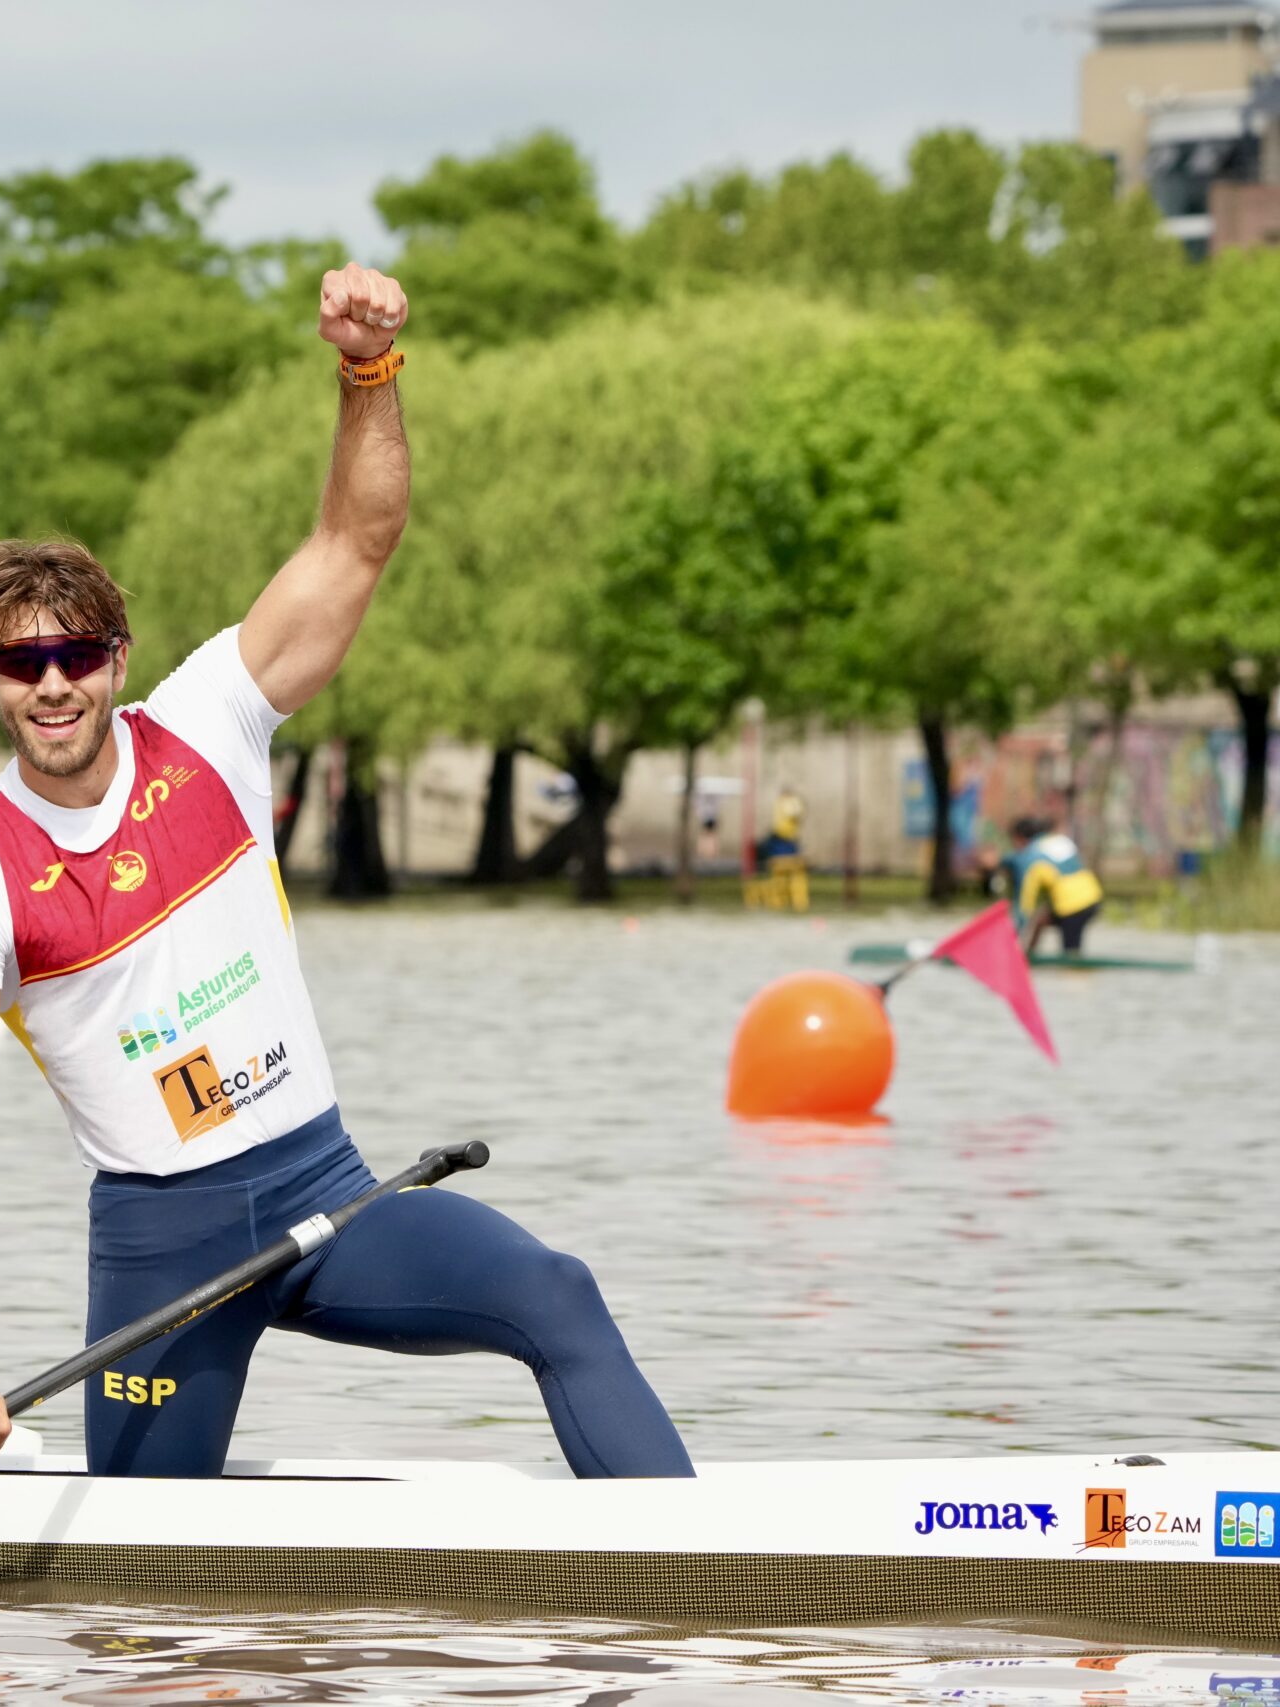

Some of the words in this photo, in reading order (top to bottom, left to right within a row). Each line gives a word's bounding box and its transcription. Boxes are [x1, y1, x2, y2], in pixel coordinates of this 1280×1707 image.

[177, 951, 255, 1018] Asturias
[183, 1000, 226, 1033] paraíso
[226, 969, 261, 1004] natural
[221, 1096, 252, 1117] GRUPO
[251, 1066, 292, 1102] EMPRESAIAL
[104, 1371, 177, 1406] ESP
[1128, 1538, 1153, 1546] GRUPO
[1153, 1539, 1200, 1547] EMPRESARIAL
